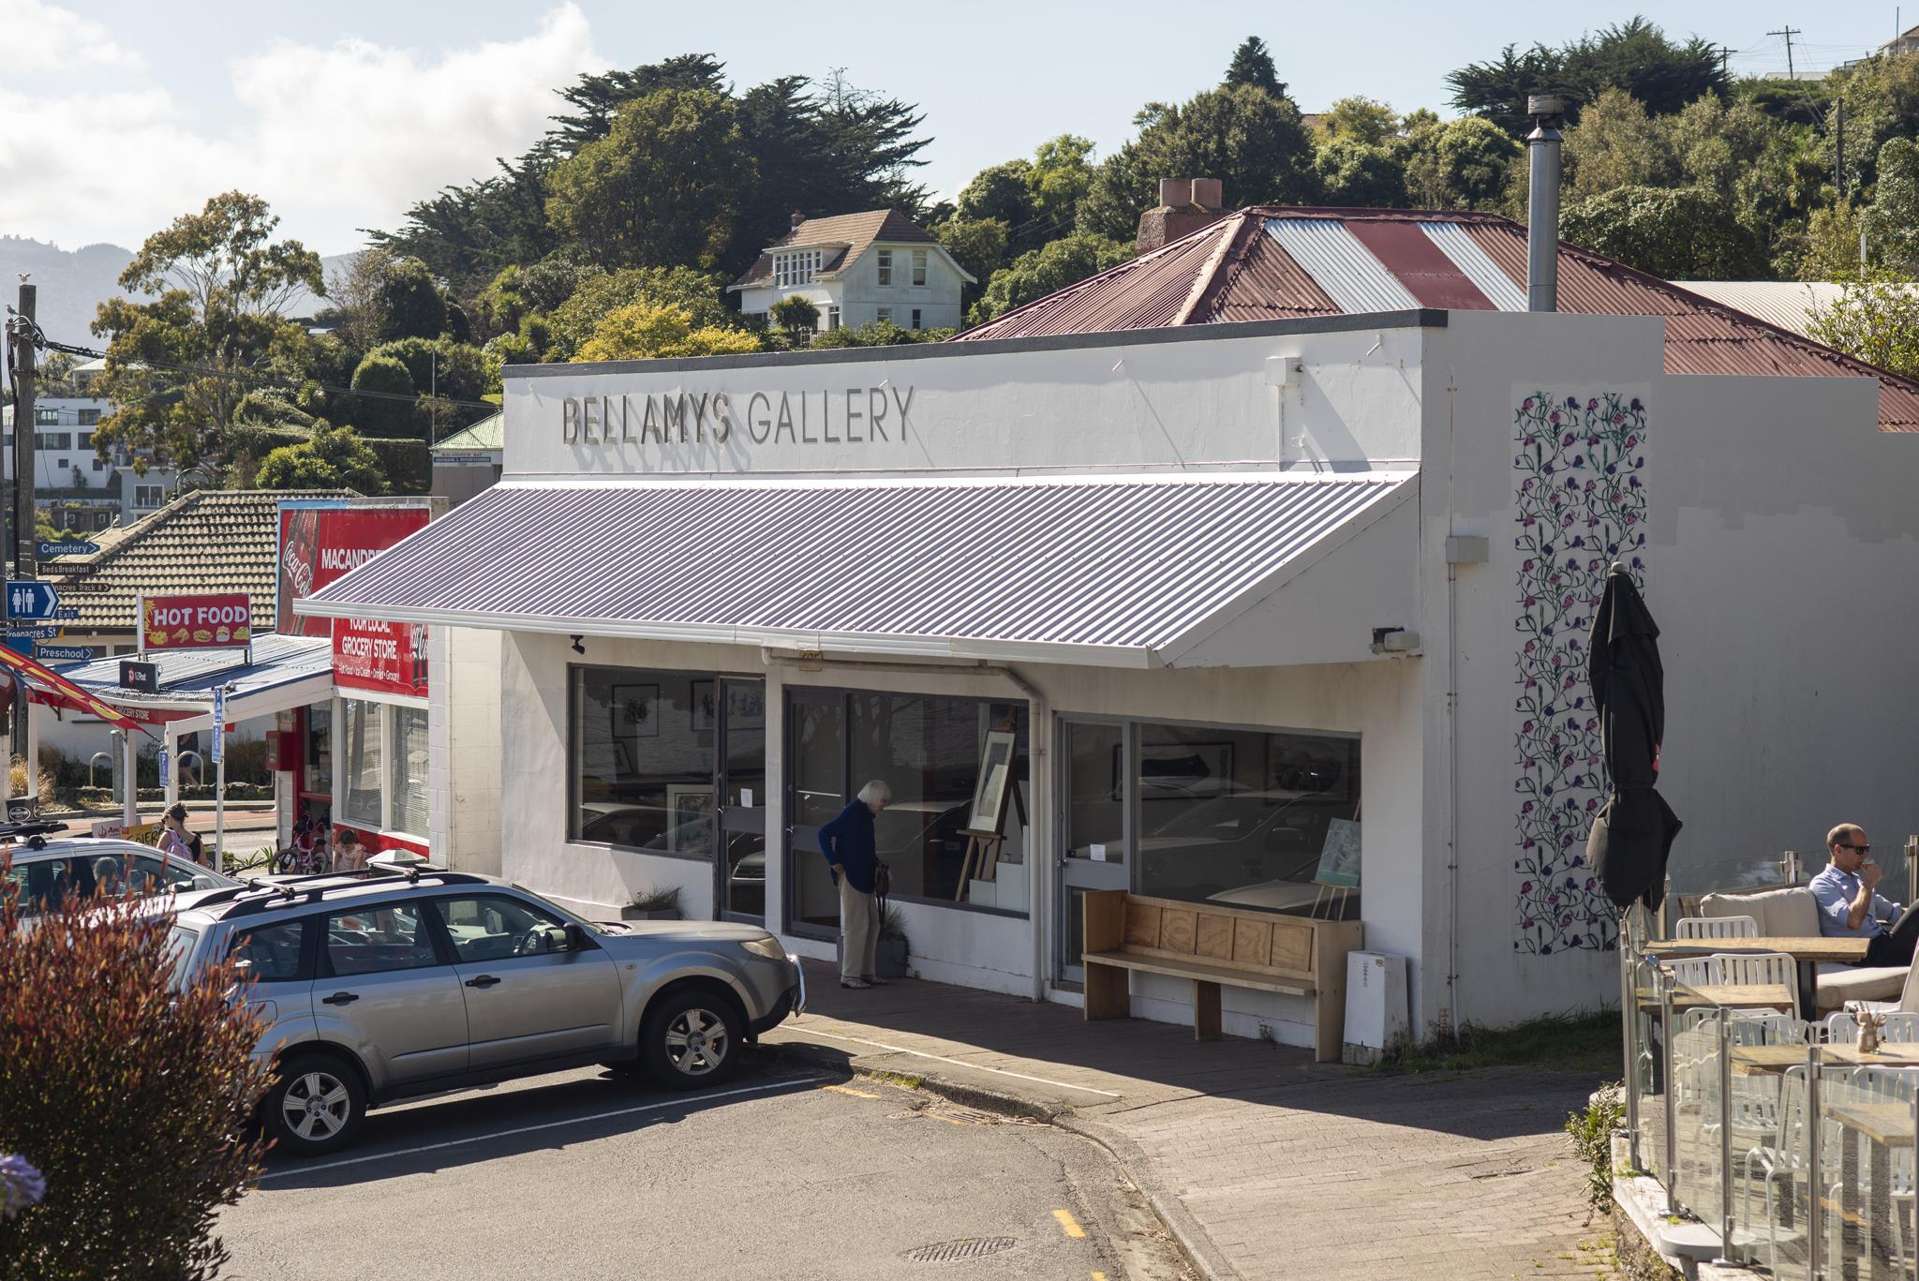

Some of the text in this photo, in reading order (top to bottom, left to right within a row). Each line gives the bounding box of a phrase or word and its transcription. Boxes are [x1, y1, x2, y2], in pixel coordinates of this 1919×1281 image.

[563, 384, 914, 445] BELLAMYS GALLERY
[41, 543, 88, 554] Cemetery
[153, 606, 248, 626] HOT FOOD
[47, 627, 57, 638] St
[40, 647, 84, 658] Preschool
[342, 636, 372, 657] GROCERY
[374, 639, 398, 660] STORE
